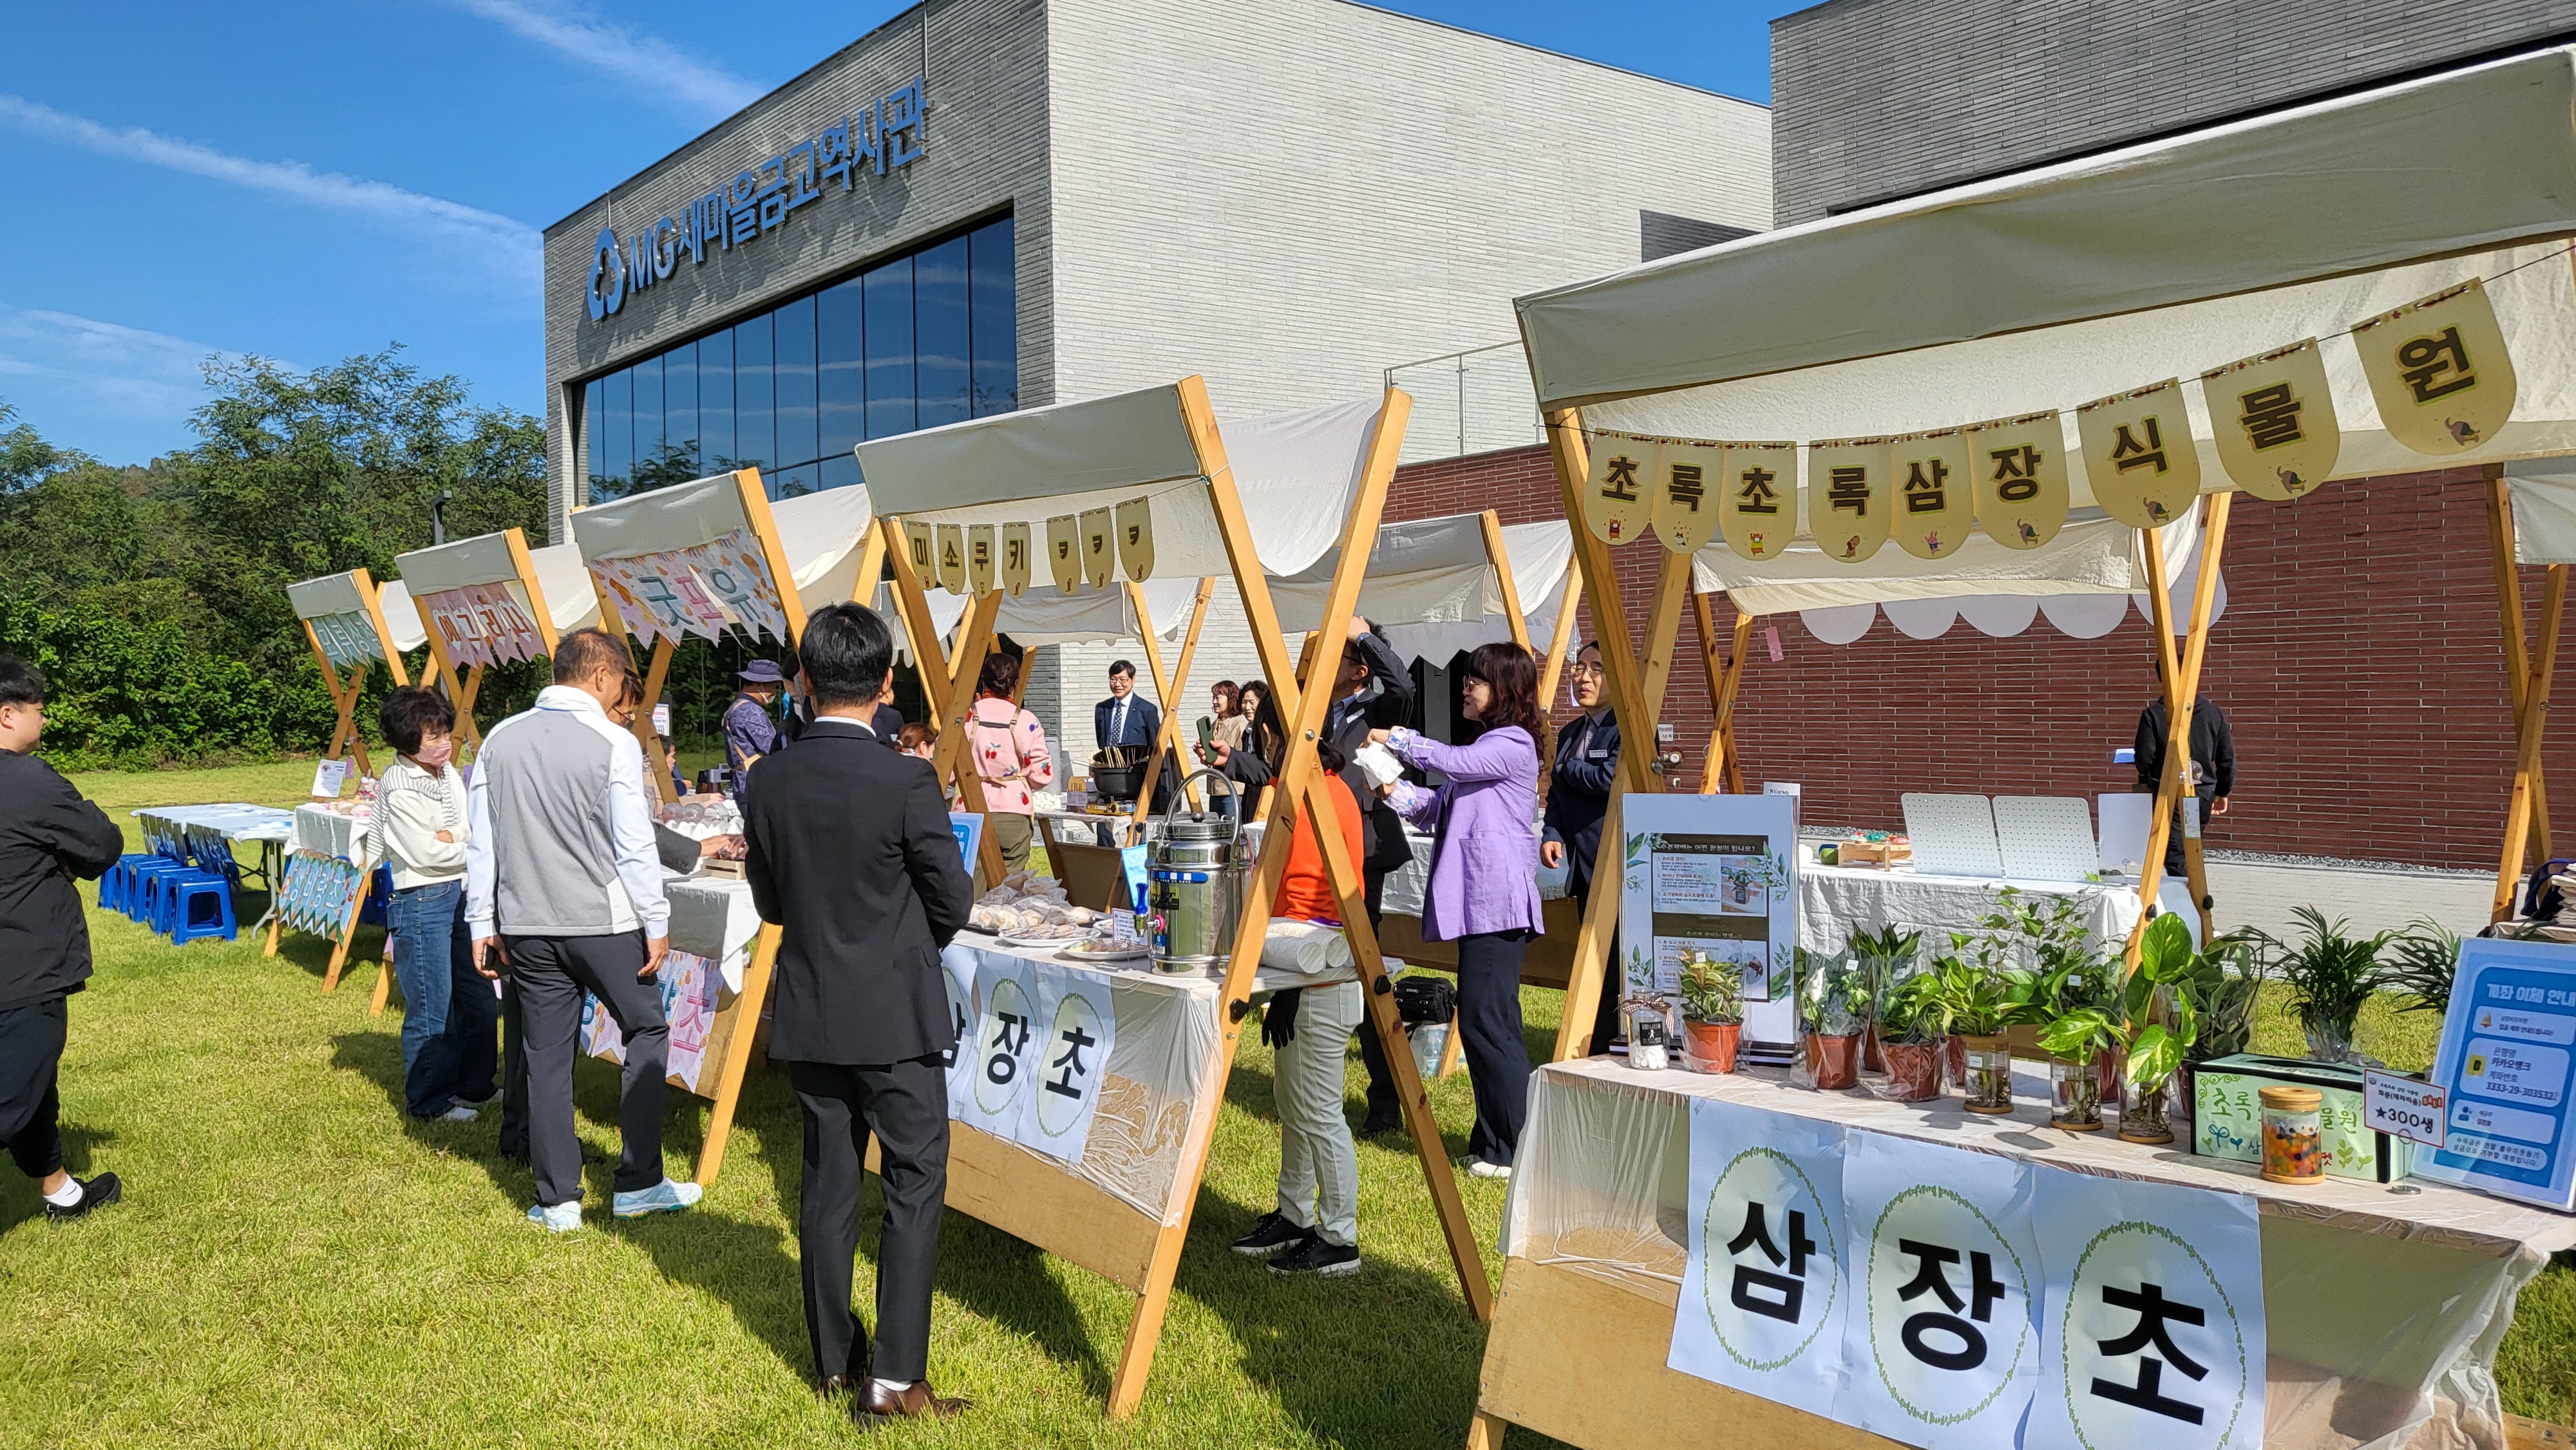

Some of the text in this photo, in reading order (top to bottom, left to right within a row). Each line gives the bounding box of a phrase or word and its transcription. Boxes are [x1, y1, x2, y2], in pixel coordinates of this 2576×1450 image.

[629, 75, 929, 294] MG새마을금고역사관
[913, 537, 1024, 571] 미소쿠키
[2490, 1057, 2532, 1071] 카카오뱅크
[2488, 1071, 2518, 1082] 계좌번호
[2423, 1097, 2442, 1107] SALE
